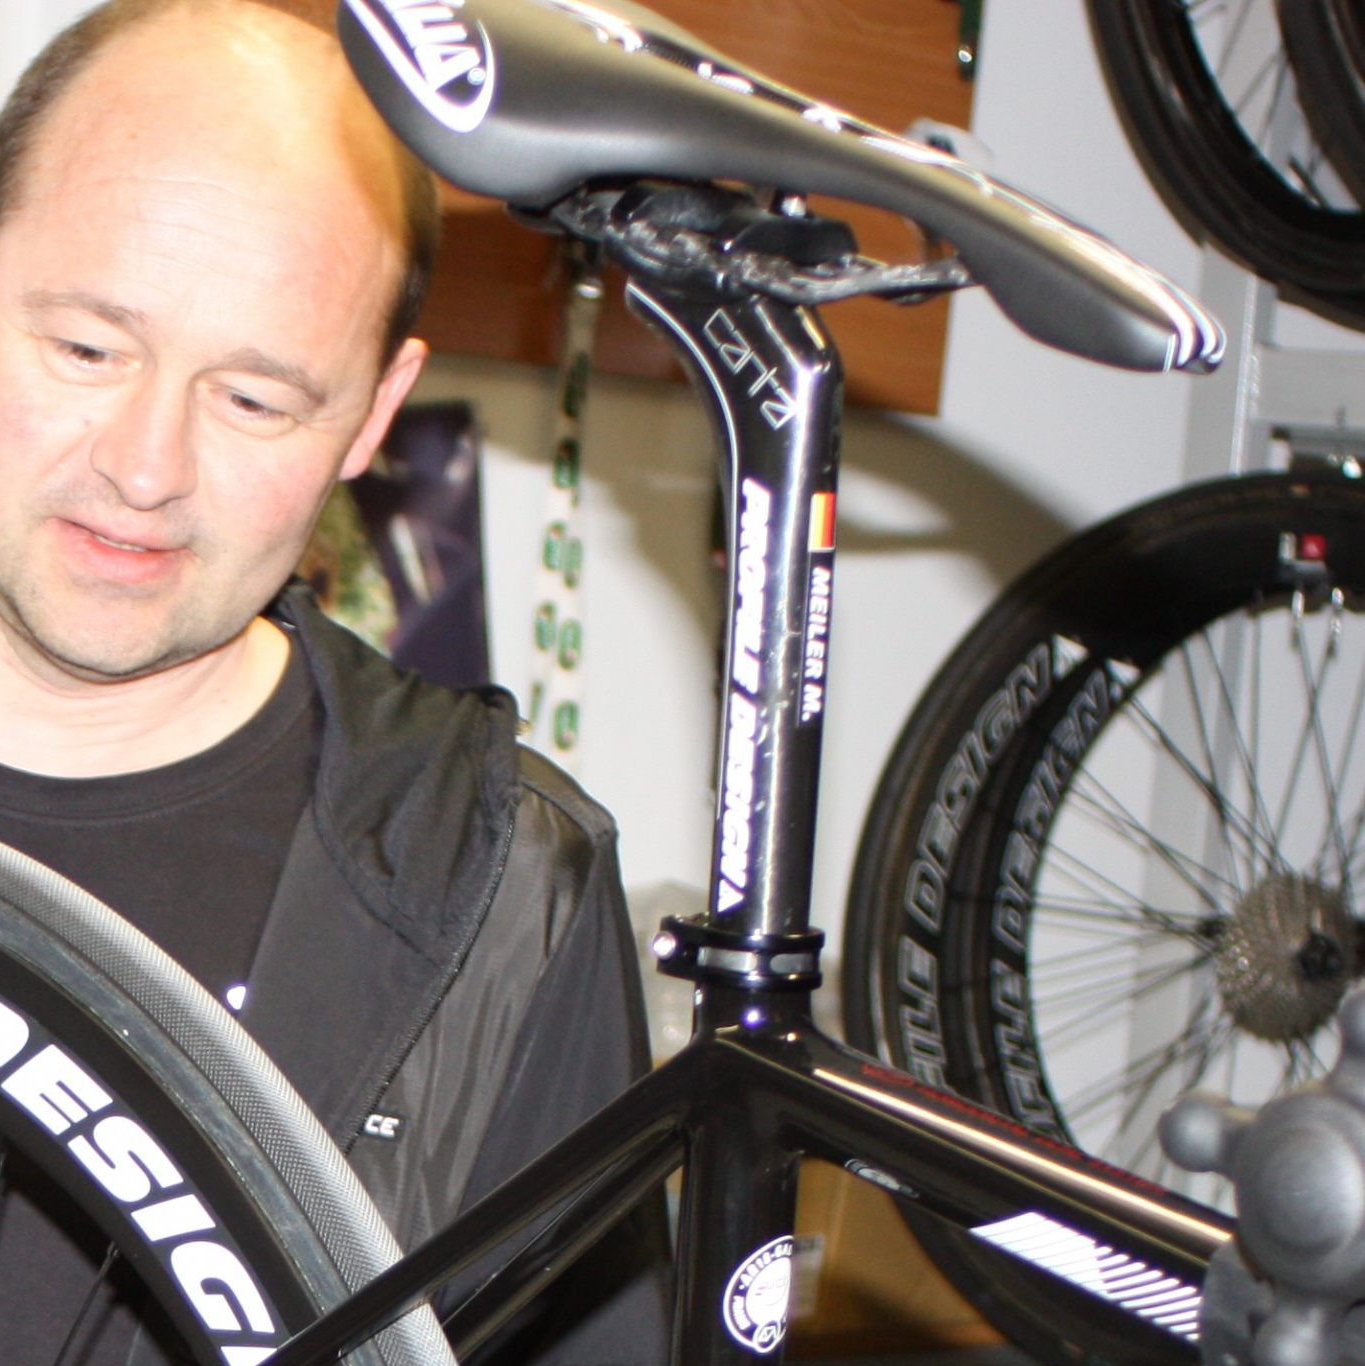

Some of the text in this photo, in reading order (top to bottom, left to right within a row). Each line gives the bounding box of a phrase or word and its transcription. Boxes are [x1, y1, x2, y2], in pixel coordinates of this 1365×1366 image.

[721, 477, 771, 888] PROFILE DESIGN
[801, 566, 831, 723] MEILER M.
